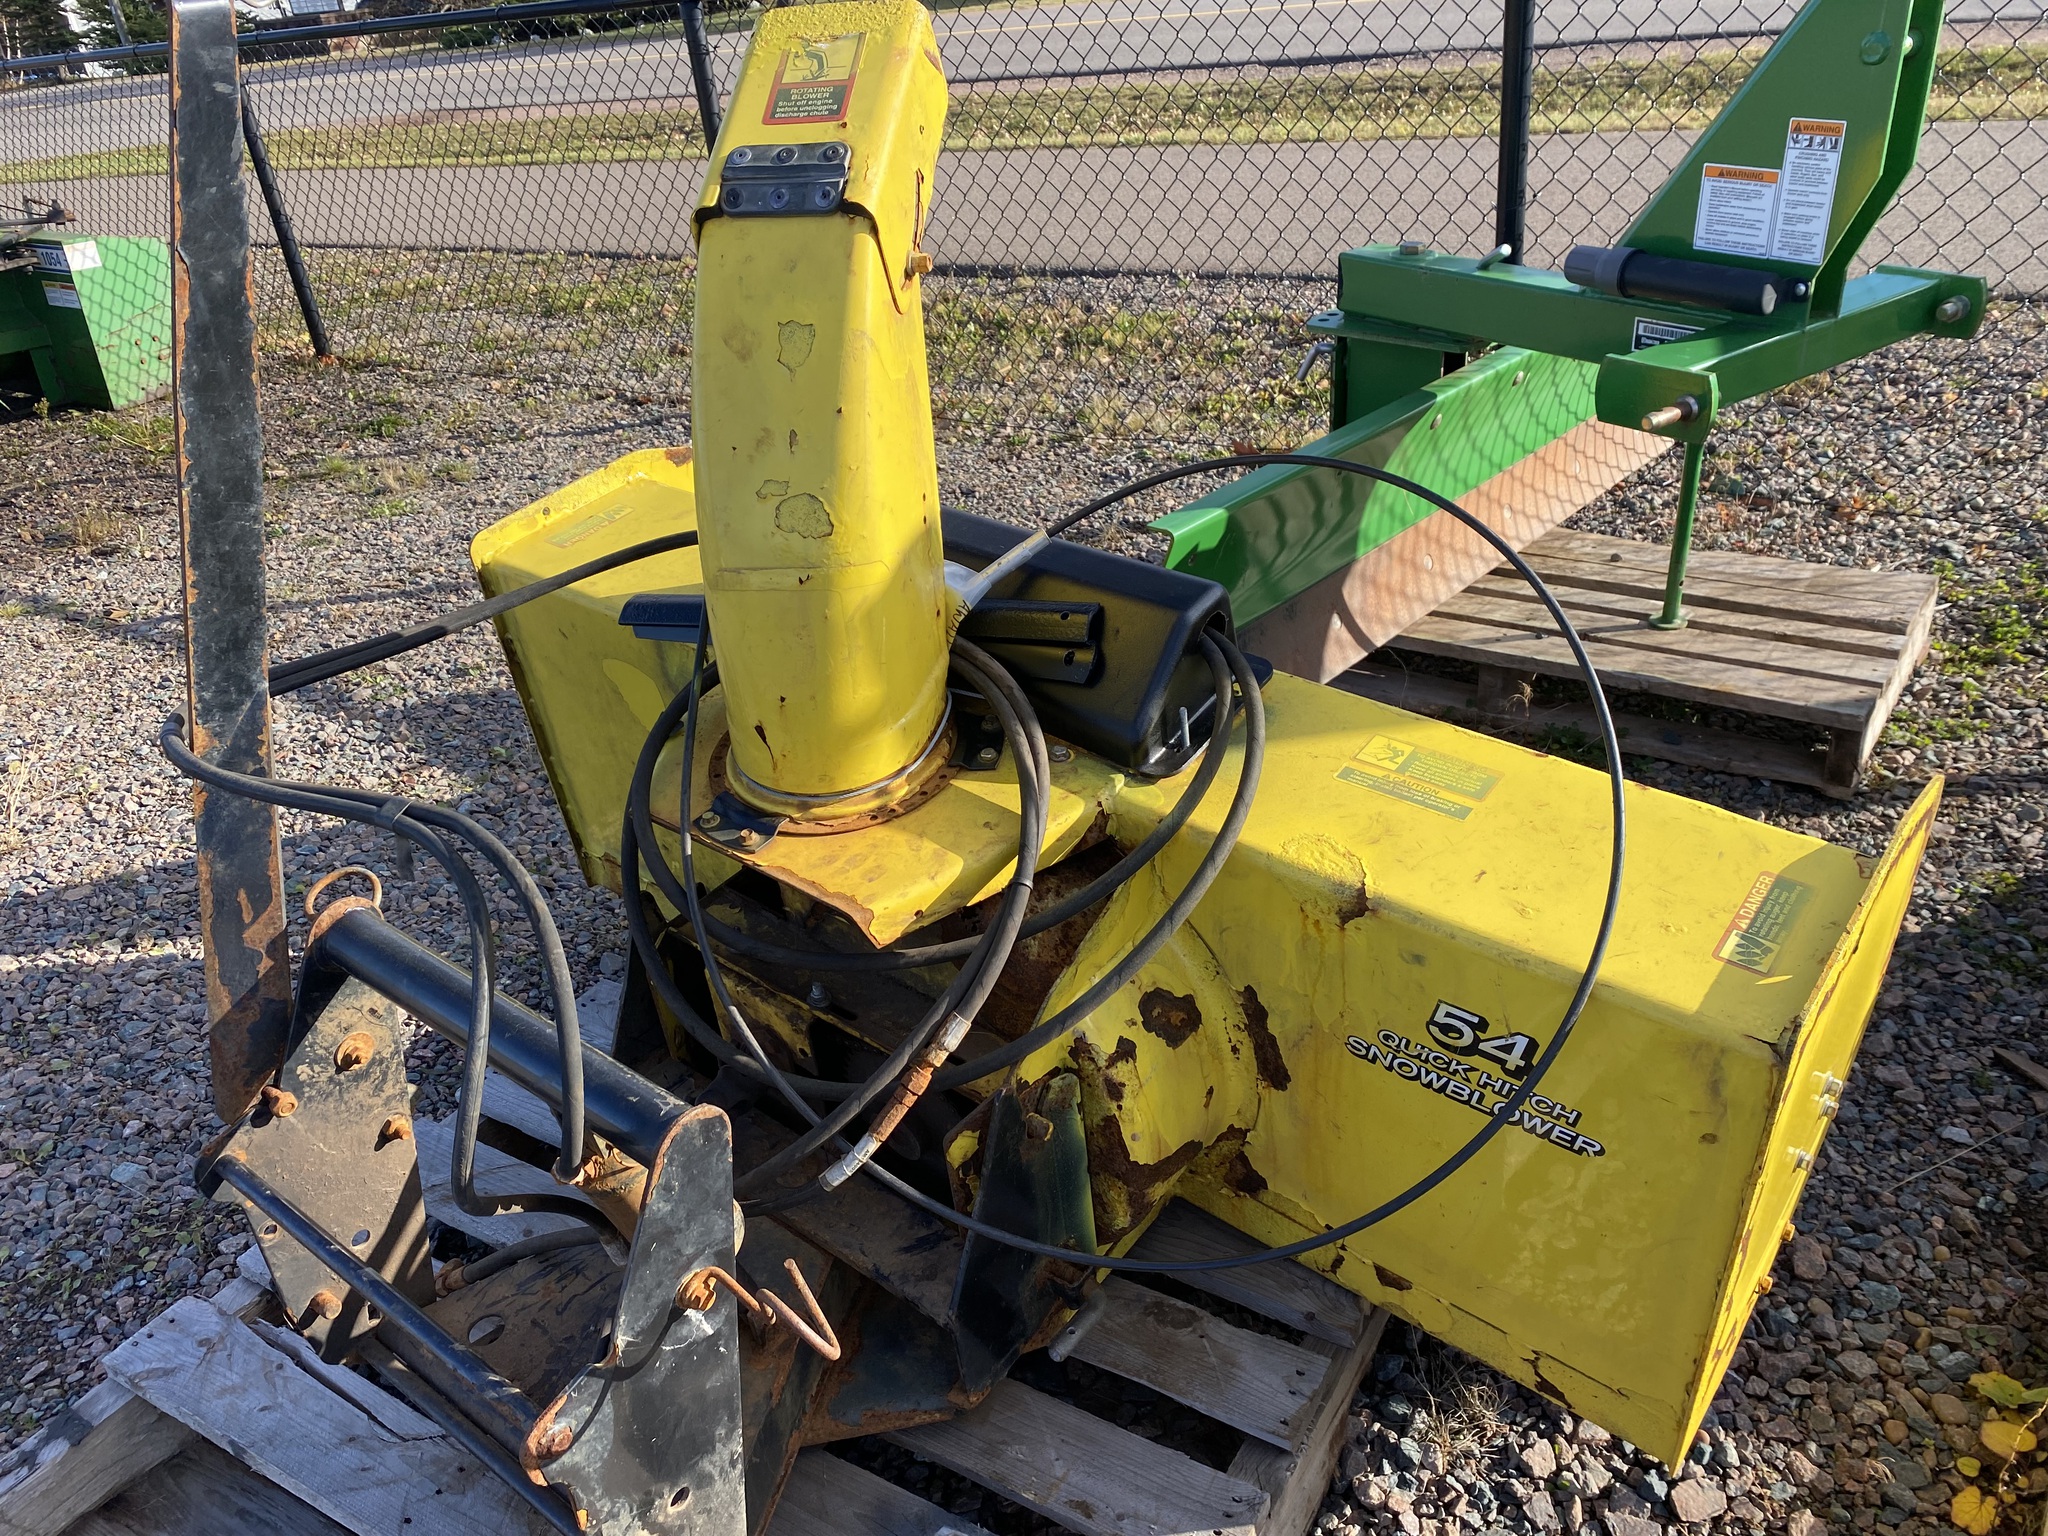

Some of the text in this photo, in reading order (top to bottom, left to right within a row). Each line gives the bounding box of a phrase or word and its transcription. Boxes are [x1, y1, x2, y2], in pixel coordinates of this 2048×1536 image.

[790, 86, 833, 94] ROTATING
[791, 92, 830, 100] BLOWER
[799, 104, 838, 112] unclogging
[808, 98, 833, 106] engine
[1802, 124, 1841, 134] WARNING
[1725, 170, 1764, 180] WARNING
[41, 251, 62, 267] 1054
[1393, 775, 1440, 796] CAUTION
[1430, 797, 1452, 806] braking
[1739, 875, 1775, 918] DANGER
[1748, 888, 1780, 934] To avoid injury from
[1759, 918, 1776, 938] rotating
[1426, 999, 1540, 1081] 54
[1377, 1028, 1583, 1128] QUICK HICH
[1344, 1034, 1607, 1158] SNOWBLOWER
